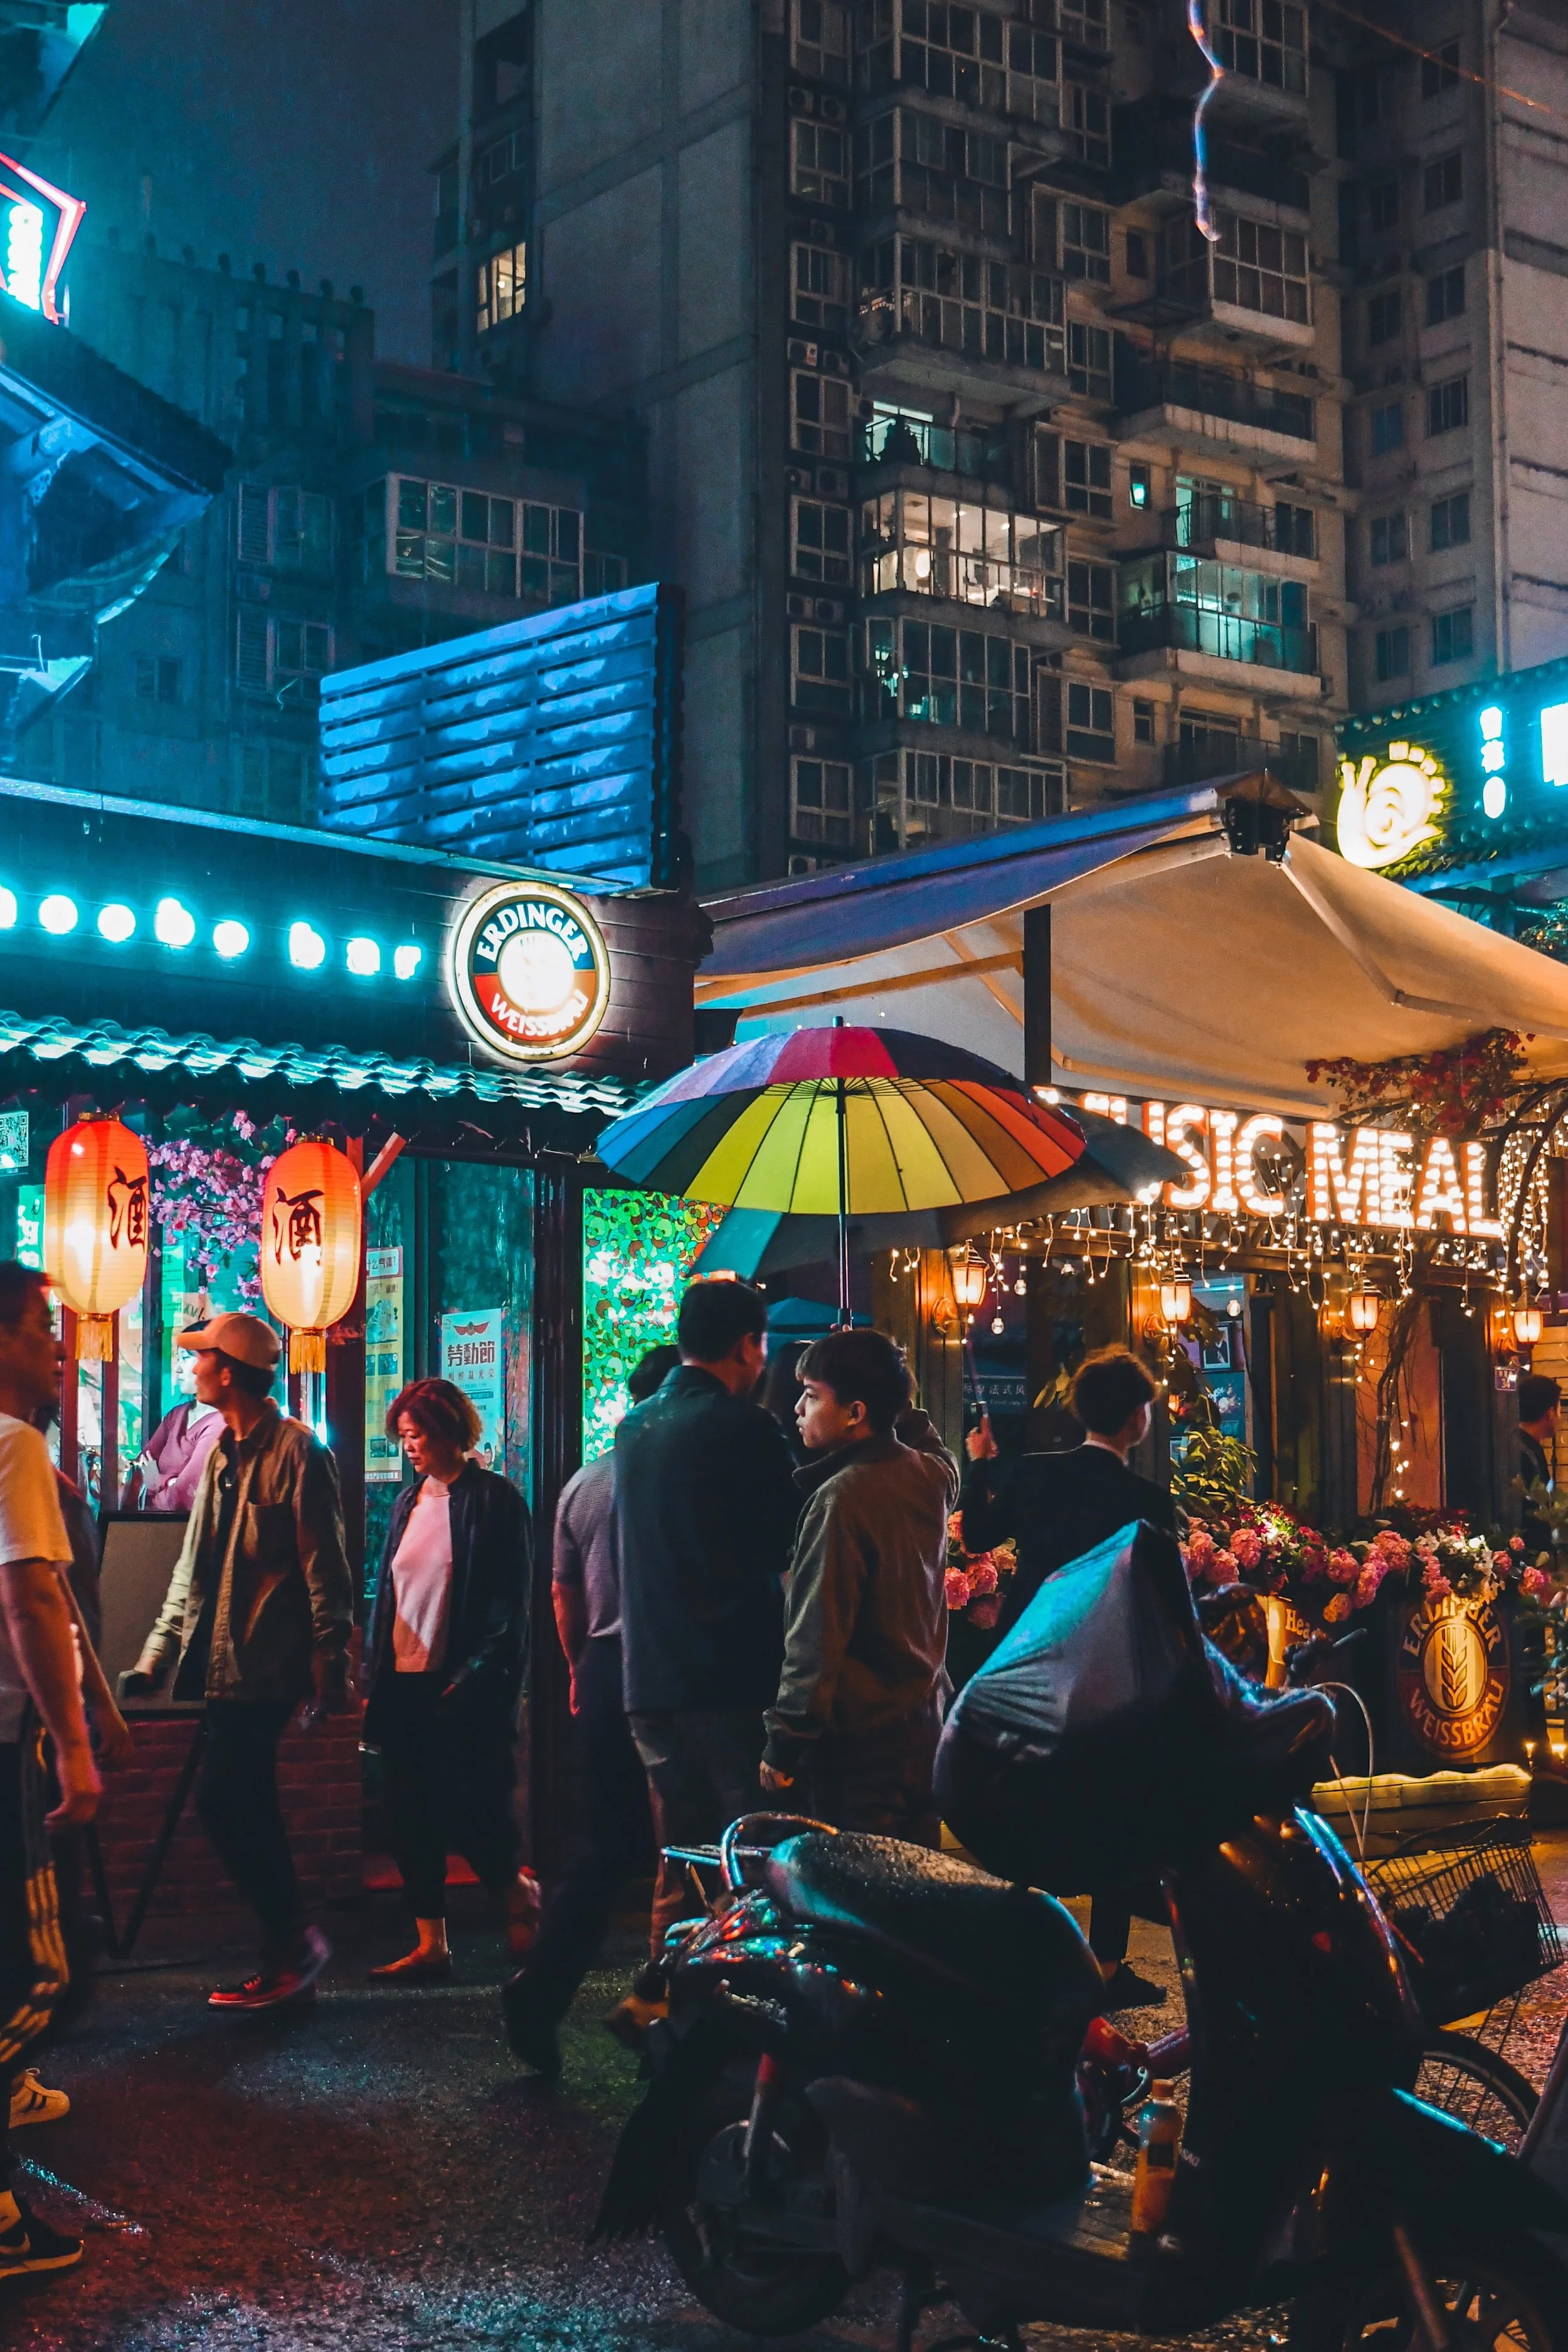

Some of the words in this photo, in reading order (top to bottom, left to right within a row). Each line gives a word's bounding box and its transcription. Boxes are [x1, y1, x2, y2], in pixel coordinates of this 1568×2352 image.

[476, 903, 588, 961] ERDINGER
[107, 1167, 147, 1252] 酒
[1306, 1121, 1503, 1238] MEAL
[272, 1187, 324, 1266] 酒
